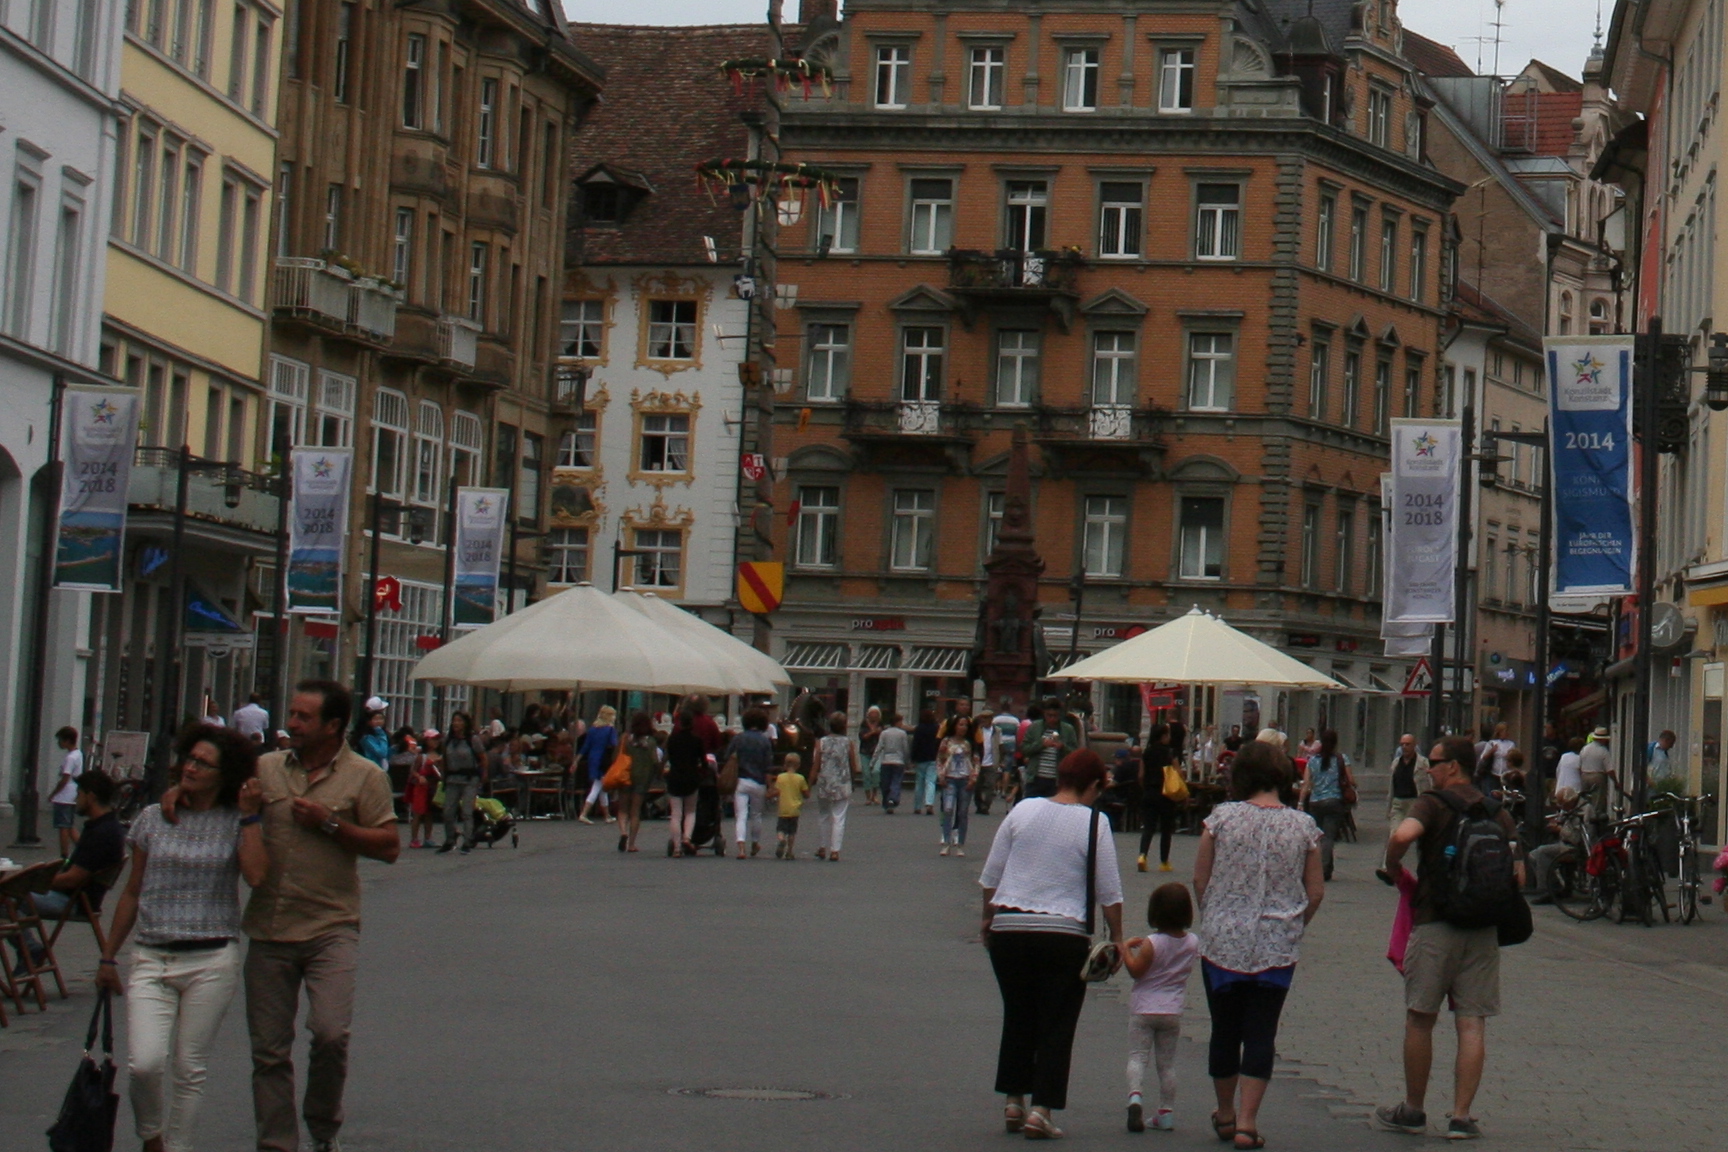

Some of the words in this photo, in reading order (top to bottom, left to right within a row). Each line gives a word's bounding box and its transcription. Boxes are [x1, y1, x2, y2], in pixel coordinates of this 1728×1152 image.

[1565, 431, 1615, 452] 2014
[80, 461, 118, 476] 2014
[1405, 493, 1444, 508] 2014
[1405, 511, 1443, 526] 2018
